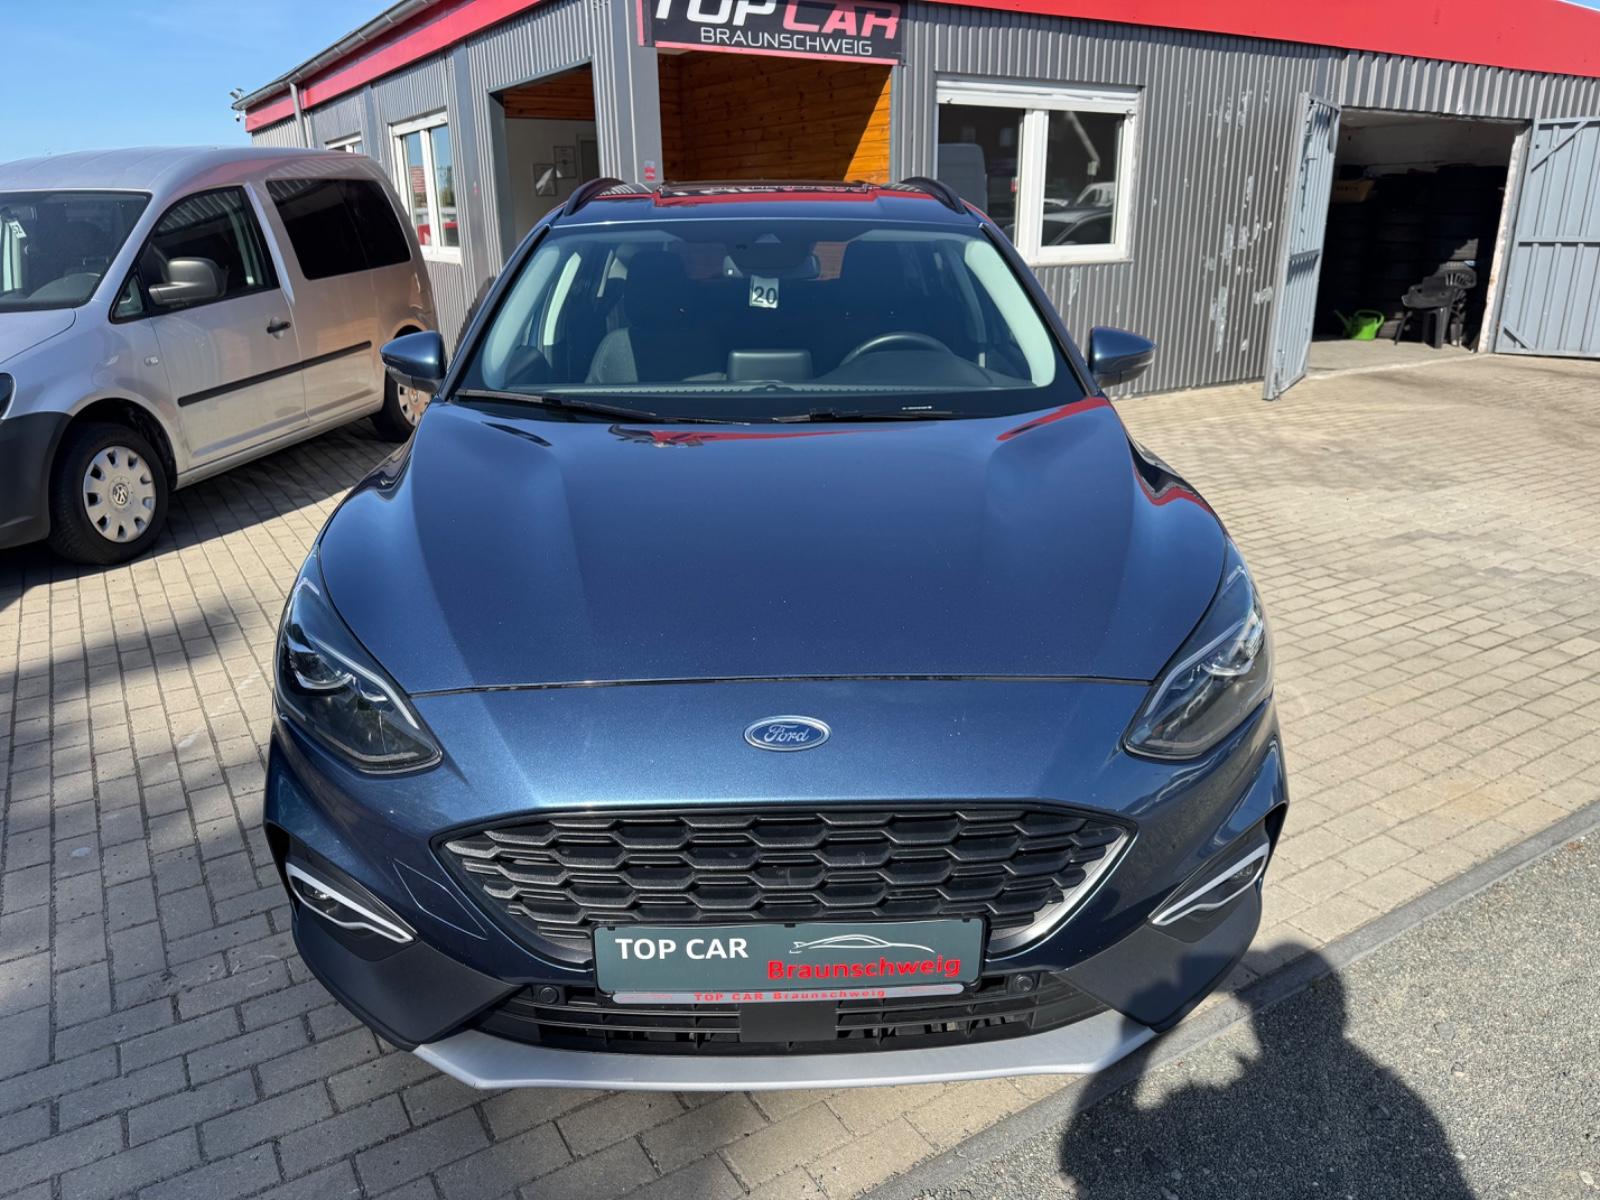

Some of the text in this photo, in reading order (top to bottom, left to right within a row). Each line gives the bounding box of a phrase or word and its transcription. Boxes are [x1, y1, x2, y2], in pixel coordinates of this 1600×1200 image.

[782, 0, 899, 39] CAR
[700, 27, 872, 56] BRAUNSCHWEIG
[753, 286, 777, 304] 20
[764, 724, 809, 742] Ford
[614, 938, 749, 960] TOP CAR
[767, 954, 961, 979] Braunschweig
[694, 990, 886, 1001] TOP CAR Braunschweig
